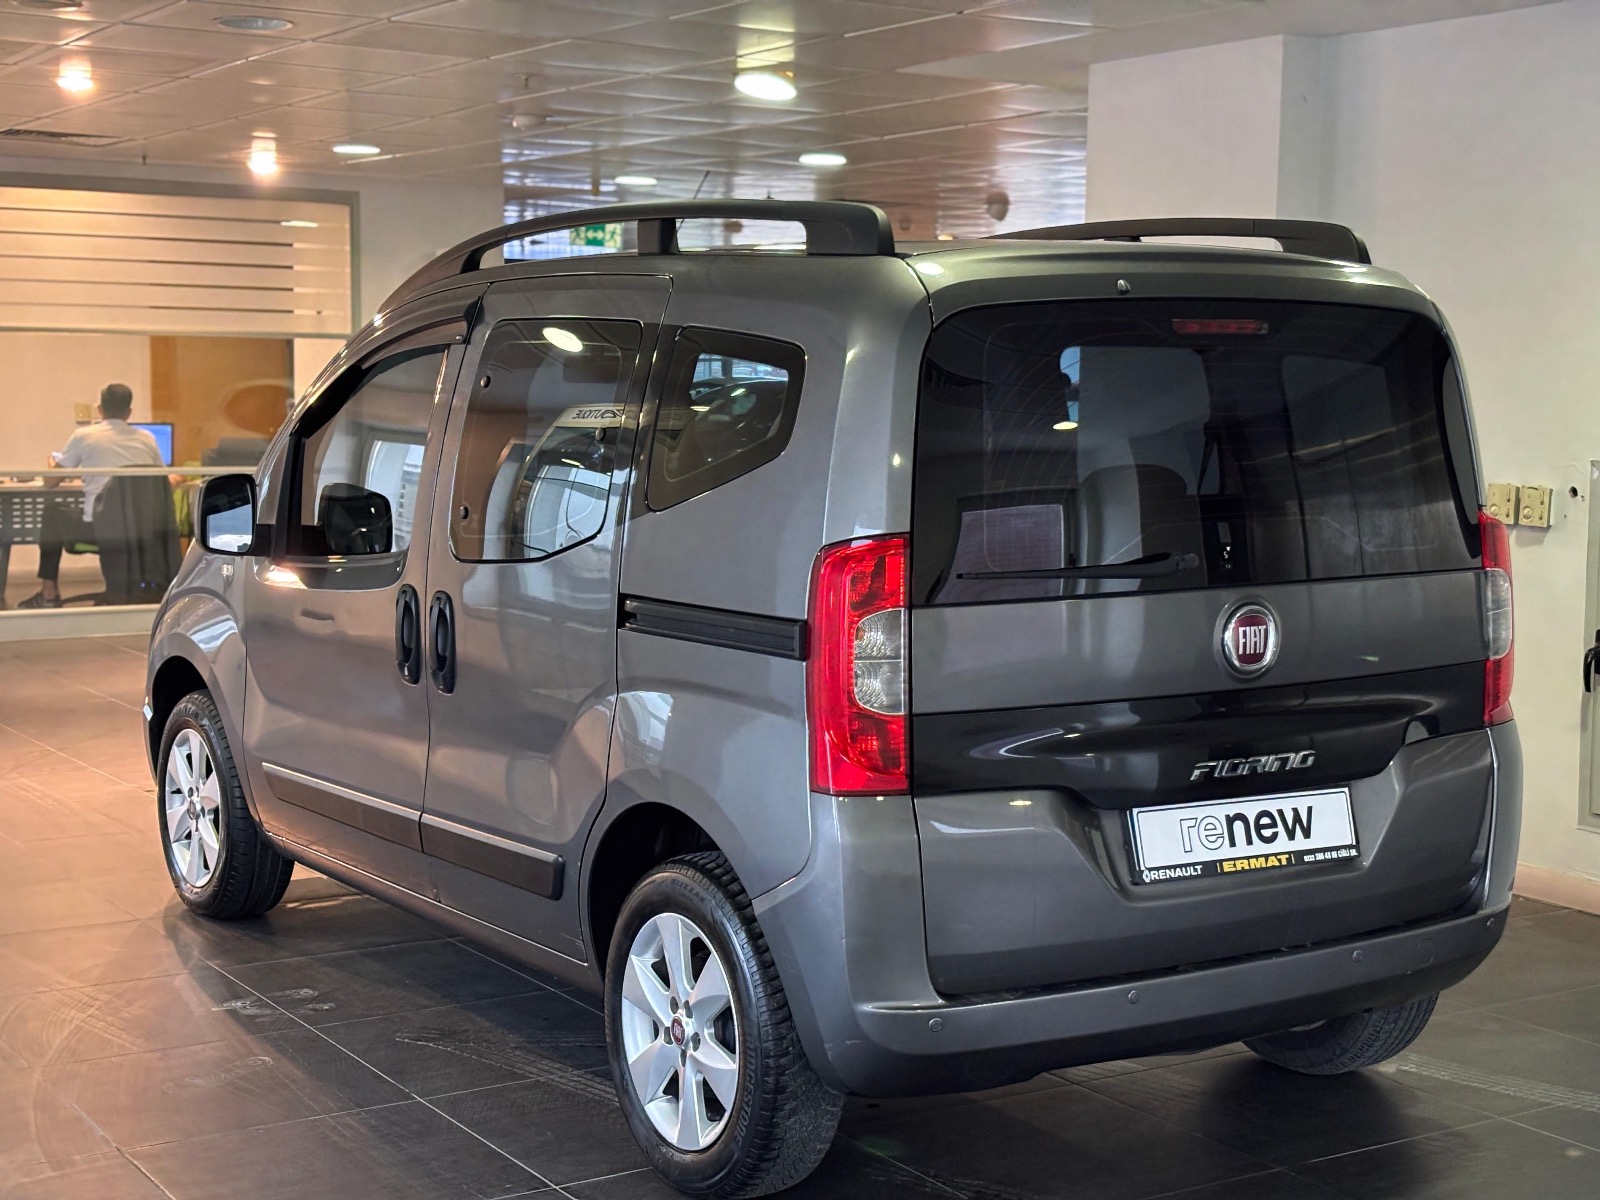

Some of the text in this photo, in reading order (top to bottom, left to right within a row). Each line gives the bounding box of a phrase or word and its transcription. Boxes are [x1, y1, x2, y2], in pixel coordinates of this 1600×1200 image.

[1238, 625, 1267, 655] FIAT
[1189, 749, 1316, 782] FIORINO
[1179, 805, 1313, 854] renew
[1150, 865, 1203, 881] RENAULT
[1222, 854, 1289, 872] ERMAT
